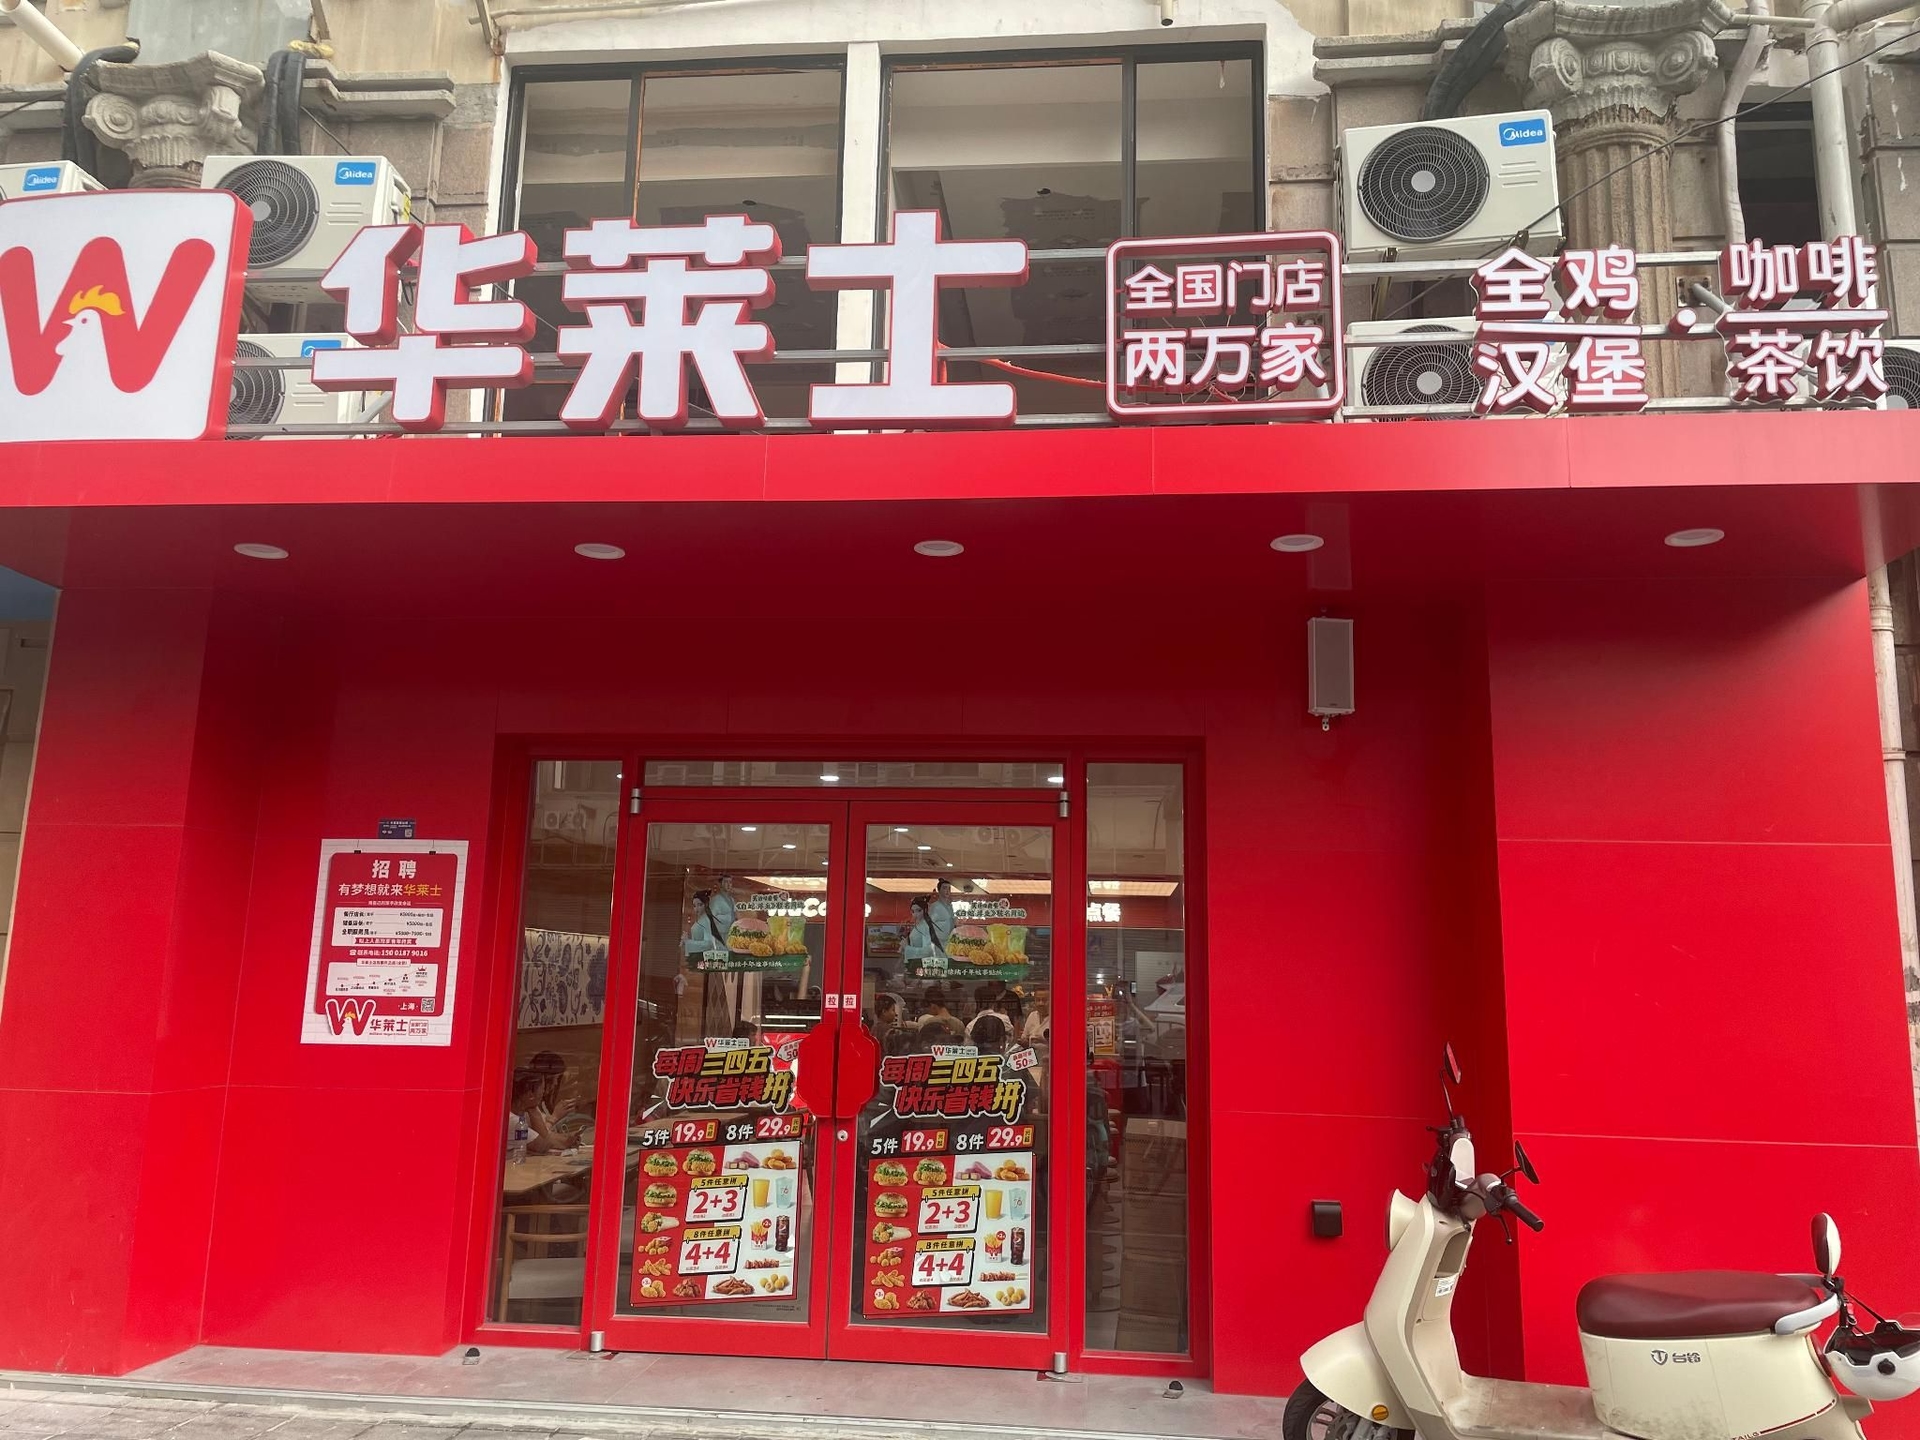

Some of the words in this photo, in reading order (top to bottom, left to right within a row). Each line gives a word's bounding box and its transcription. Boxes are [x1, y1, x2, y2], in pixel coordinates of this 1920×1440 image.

[1503, 128, 1543, 140] Midea
[27, 174, 58, 187] Midea
[338, 167, 374, 179] Midea
[1476, 244, 1639, 319] 全鸡
[1723, 236, 1879, 306] 咖啡
[1124, 261, 1324, 316] 全国门店
[312, 209, 1029, 429] 华莱士
[1124, 322, 1327, 392] 两万家
[1726, 329, 1888, 402] 茶饮
[1475, 337, 1648, 412] 汉堡
[371, 859, 417, 879] 招聘
[338, 883, 443, 897] 有梦想就来华莱士
[370, 1019, 408, 1032] 华莱士
[655, 1047, 773, 1076] 每周三四五
[882, 1055, 1003, 1084] 每周三四五
[669, 1071, 792, 1110] 快乐省钱拼
[896, 1081, 1023, 1121] 快乐省钱拼
[644, 1128, 670, 1147] 5件
[674, 1122, 705, 1142] 19.9
[726, 1123, 753, 1141] 8件
[758, 1117, 791, 1137] 29.9
[956, 1133, 984, 1151] 8件
[989, 1127, 1023, 1146] 29.9
[871, 1137, 899, 1155] 5件
[904, 1131, 935, 1151] 19.9
[693, 1189, 738, 1214] 2+3
[924, 1200, 971, 1225] 2+3
[685, 1241, 731, 1266] 4+4
[918, 1252, 965, 1277] 4+4
[1672, 1352, 1701, 1364] 台铃
